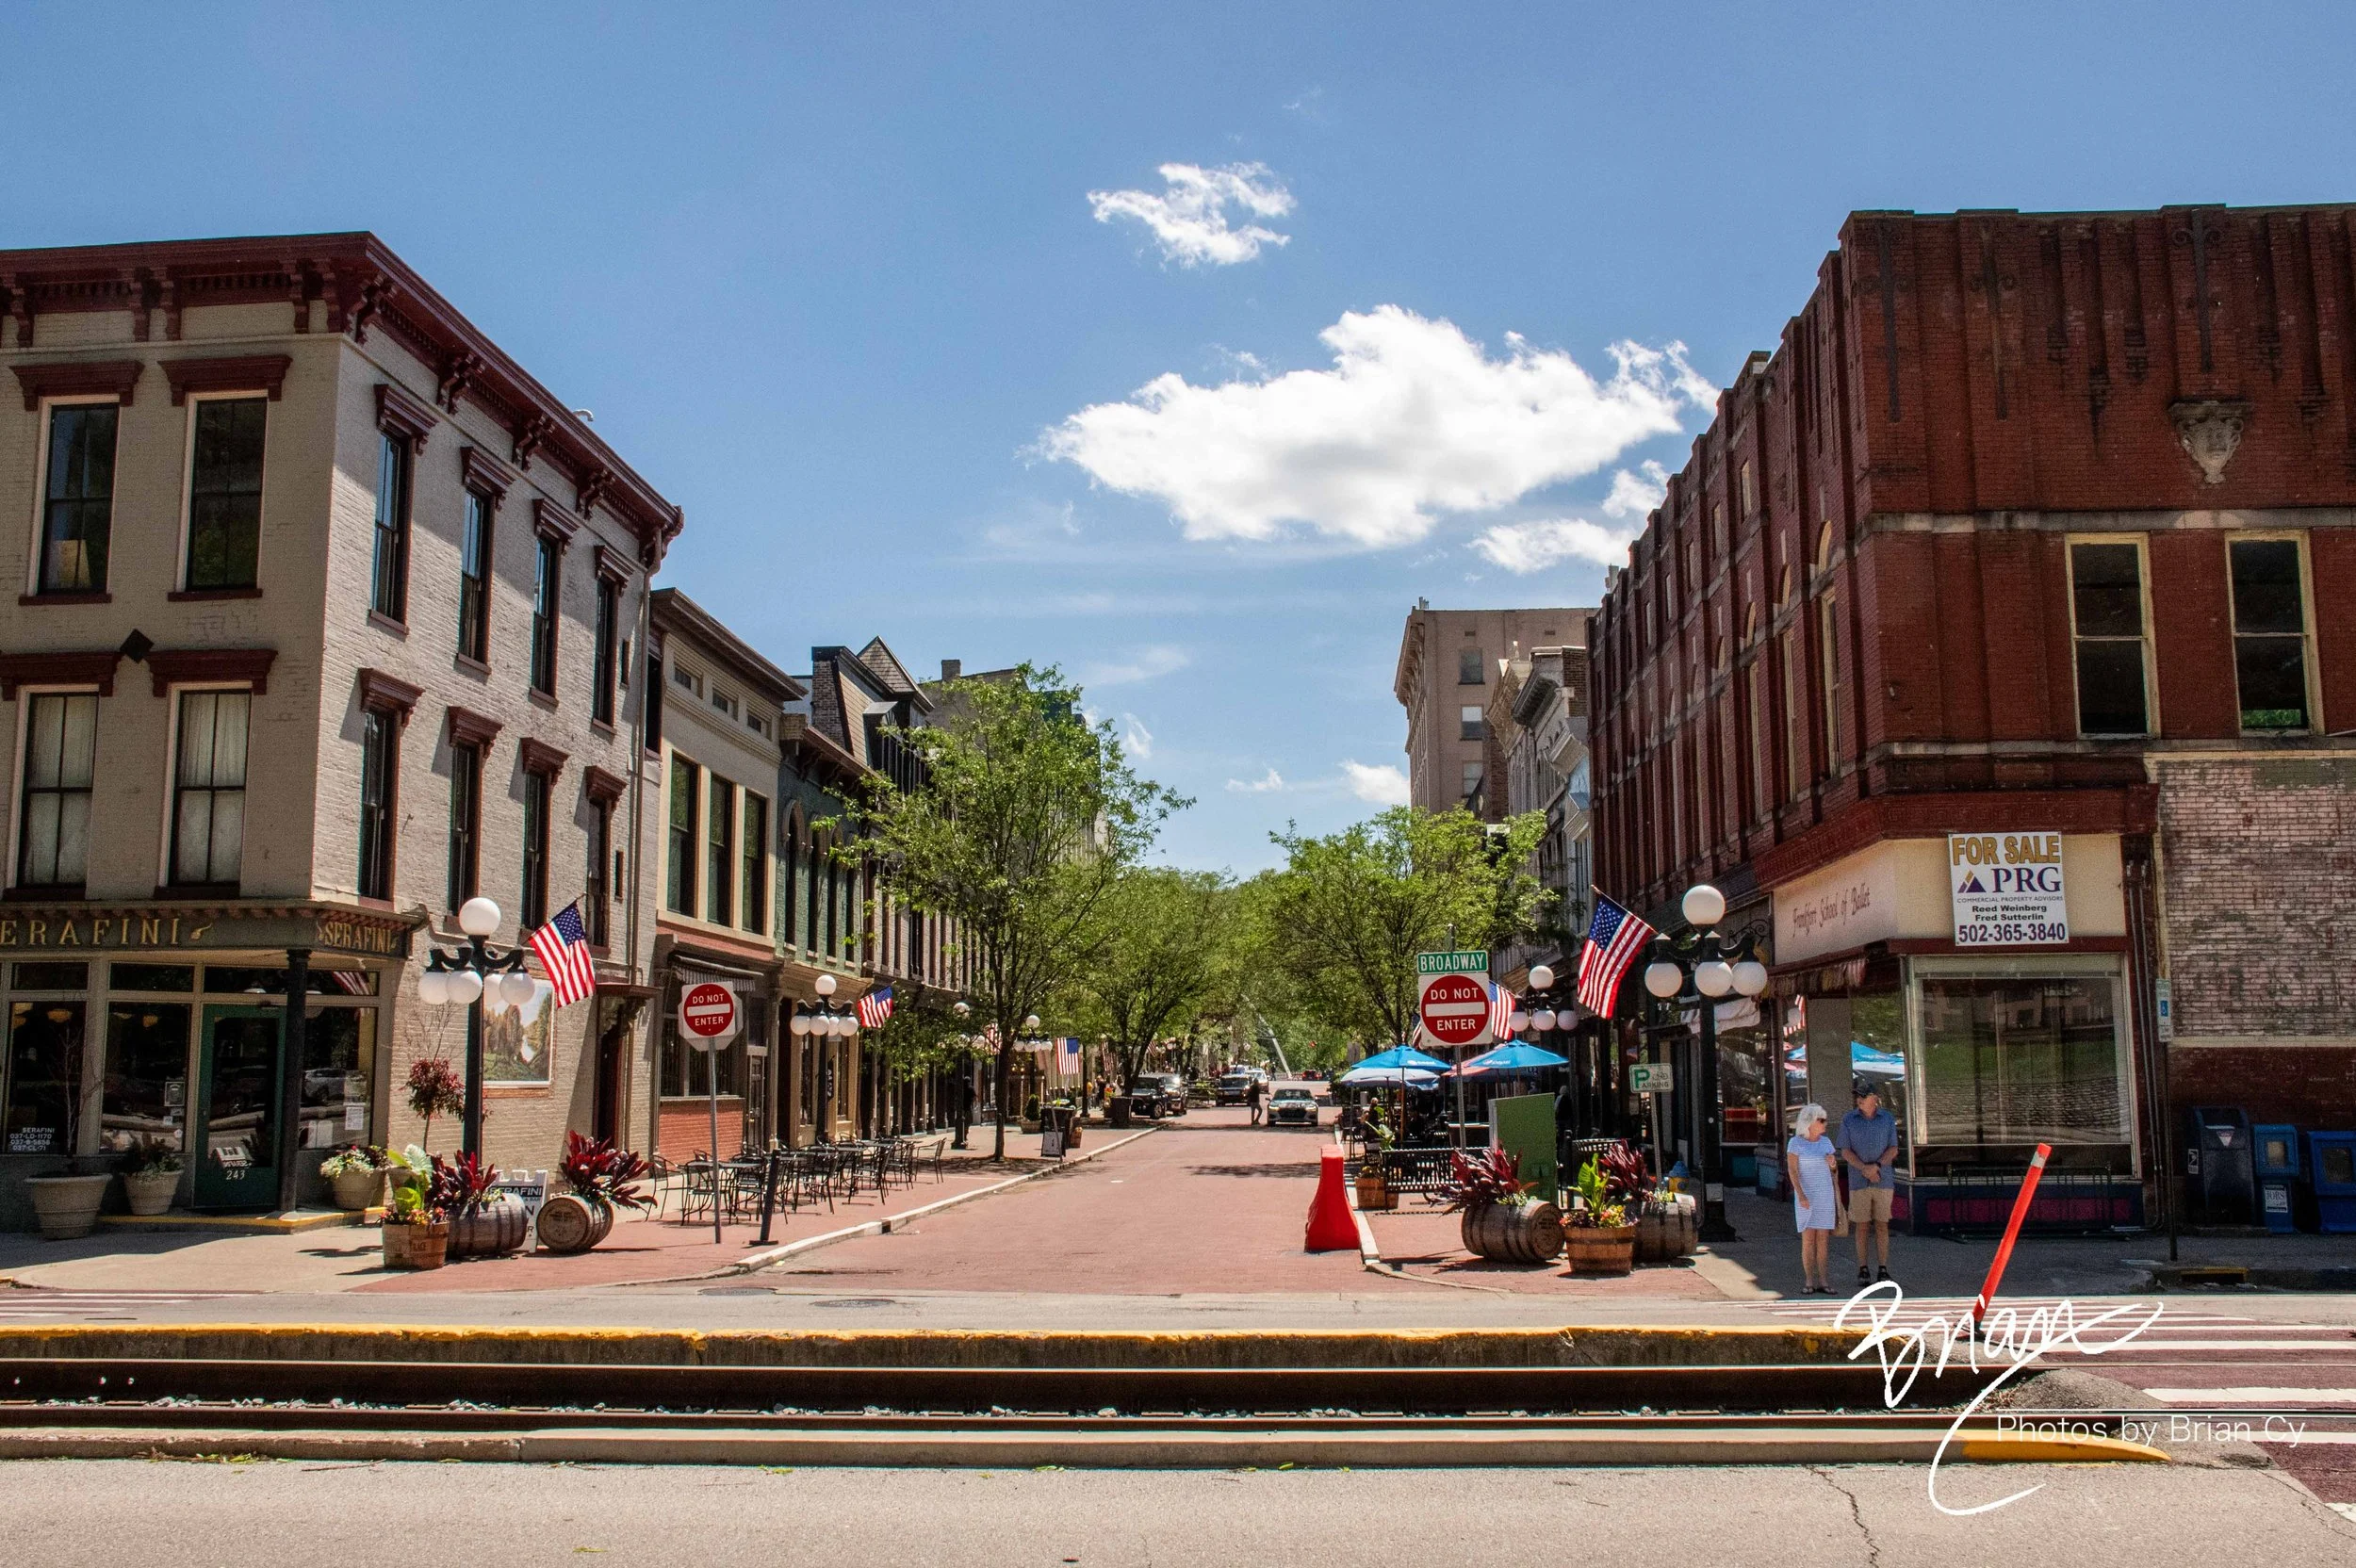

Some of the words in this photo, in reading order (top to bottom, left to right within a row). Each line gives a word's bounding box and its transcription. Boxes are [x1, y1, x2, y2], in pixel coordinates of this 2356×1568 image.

[1952, 837, 2000, 865] FOR
[2004, 835, 2060, 864] SALE
[1991, 866, 2061, 893] PRG
[1820, 891, 1839, 927] School
[1851, 882, 1871, 915] Ballet
[2000, 905, 2047, 914] Weinberg
[324, 921, 391, 954] SERAFINI
[1958, 923, 2066, 942] 502-365-3840
[1420, 954, 1483, 972] BROADWAY
[692, 995, 705, 1004] DO
[707, 993, 725, 1004] NOT
[1431, 988, 1448, 1000] DO
[1453, 988, 1479, 999] NOT
[695, 1016, 724, 1026] ENTER
[1436, 1019, 1476, 1031] ENTER
